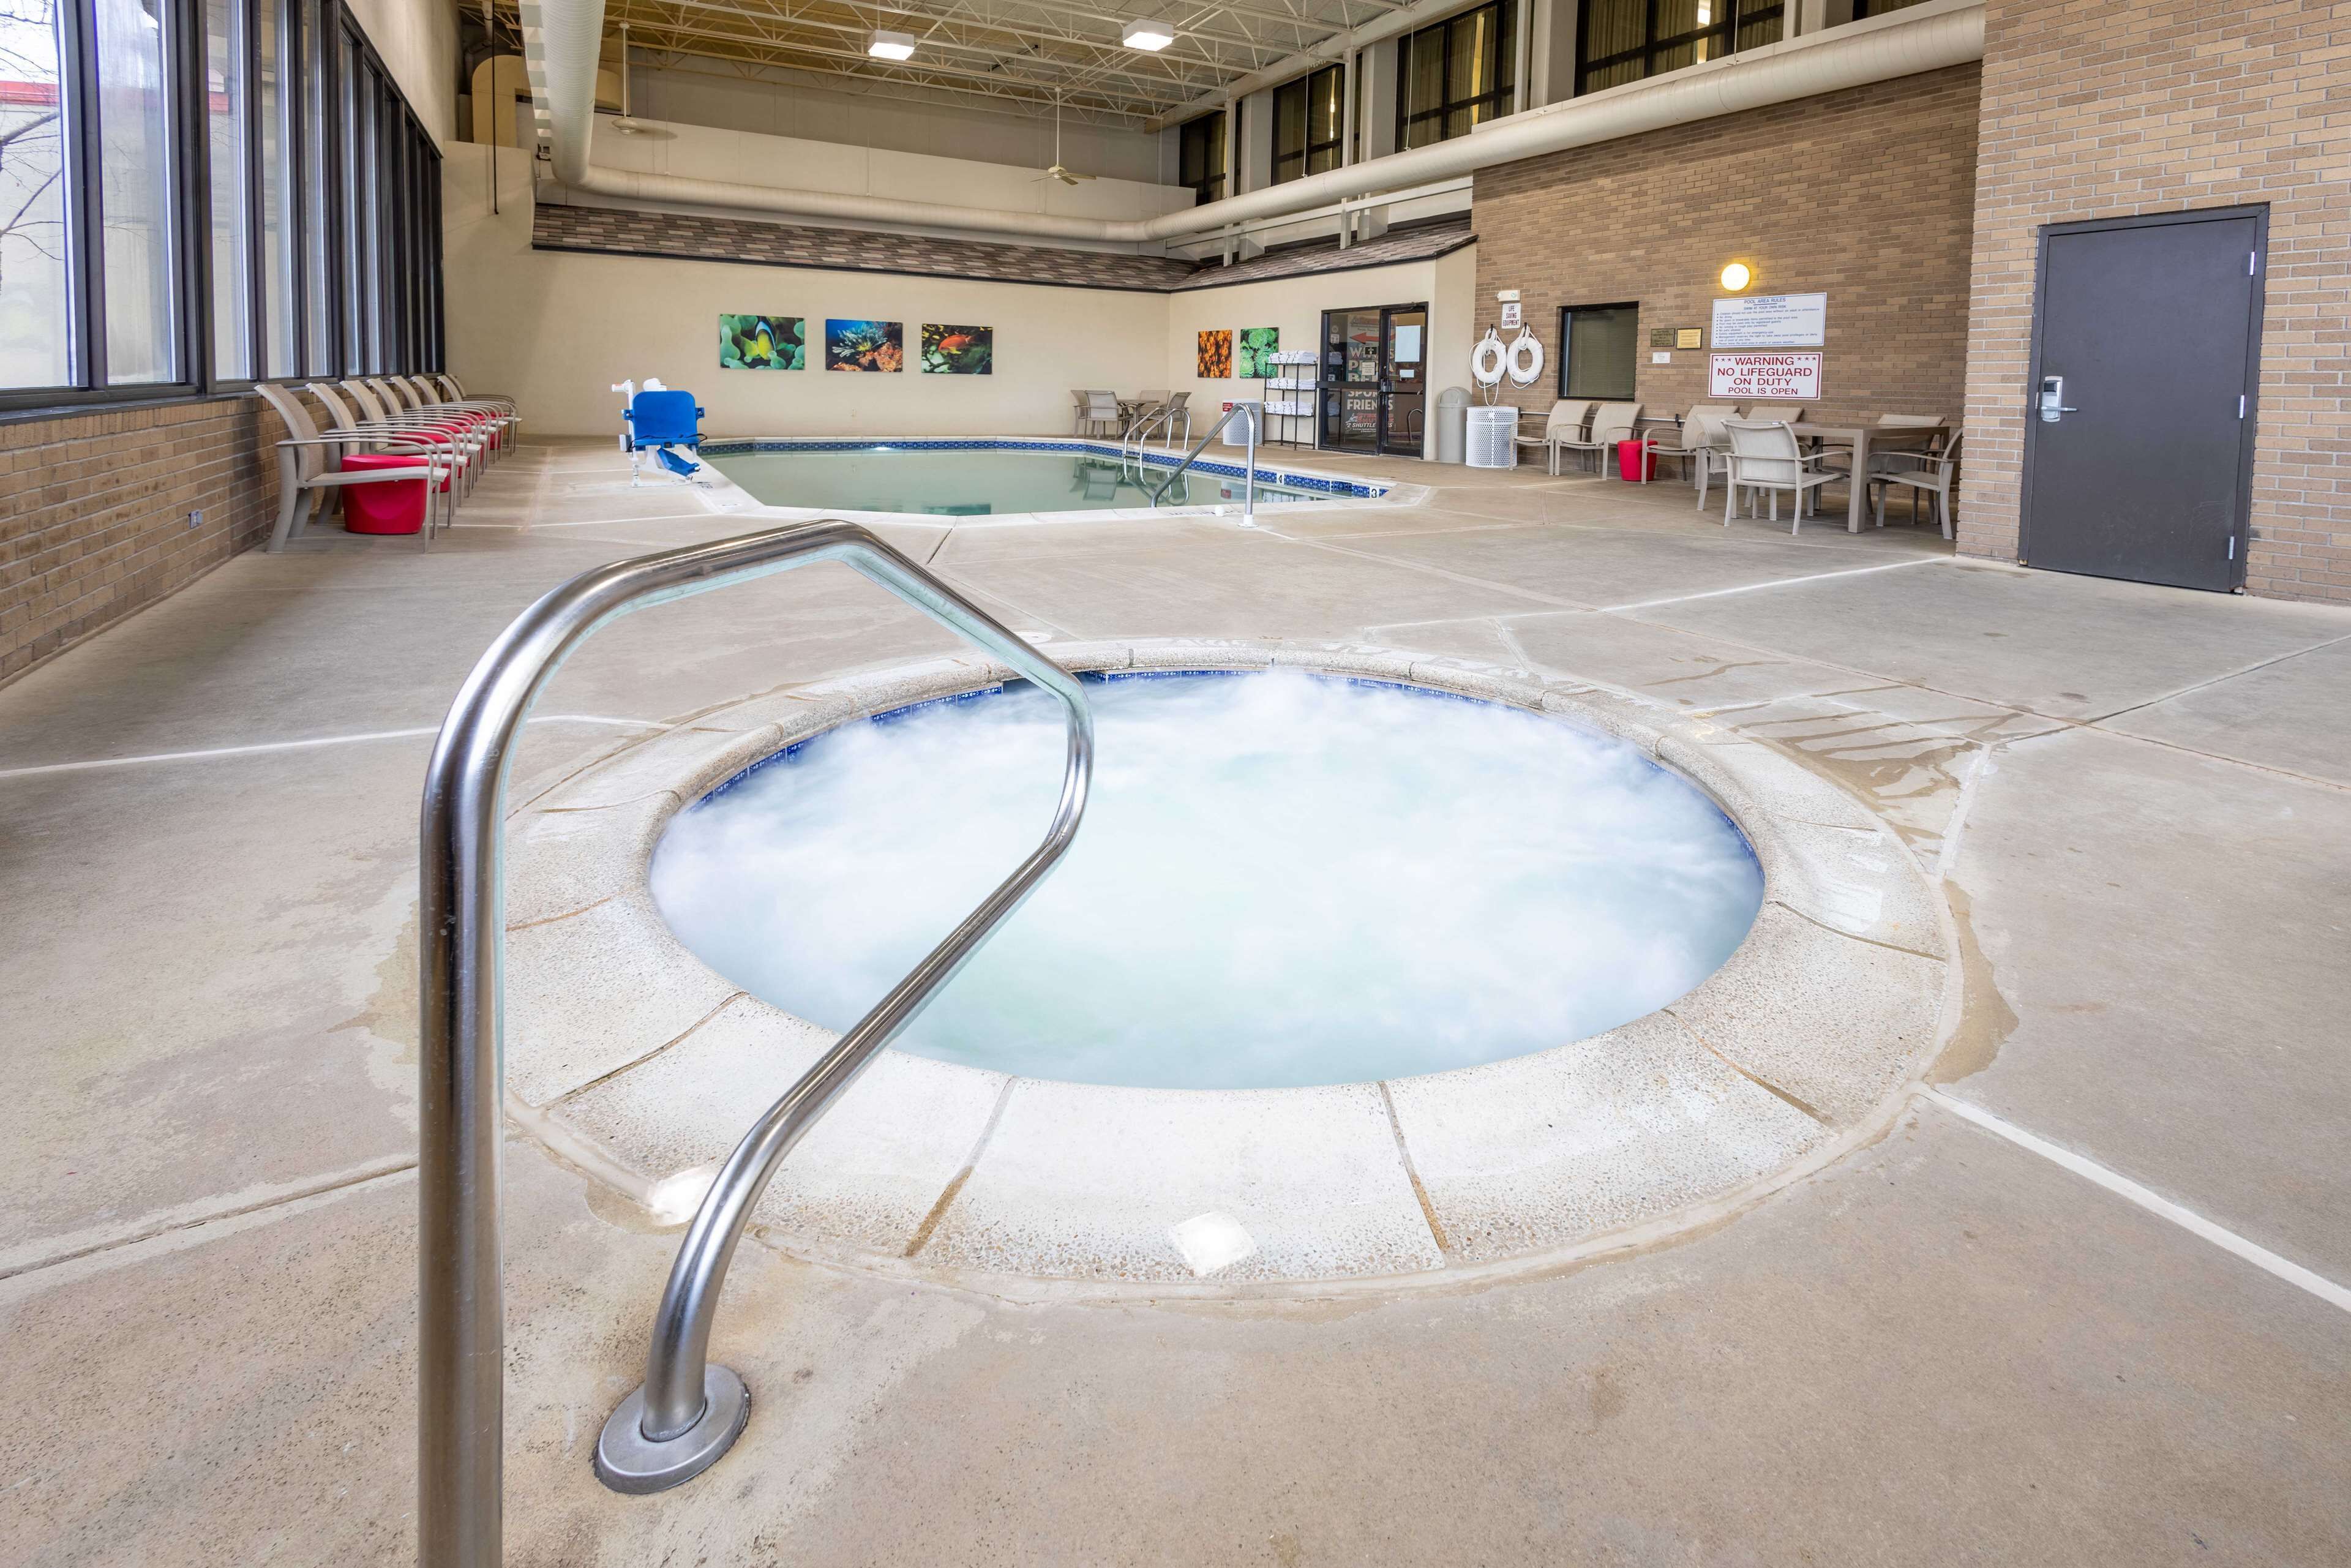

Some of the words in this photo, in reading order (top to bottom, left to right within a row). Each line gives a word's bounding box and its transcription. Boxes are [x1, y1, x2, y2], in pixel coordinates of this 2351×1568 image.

[1735, 357, 1794, 366] WARNING
[1717, 367, 1734, 376] NO
[1741, 367, 1812, 377] LIFEGUARD
[1347, 399, 1393, 410] FRIENS
[1371, 489, 1377, 498] 3
